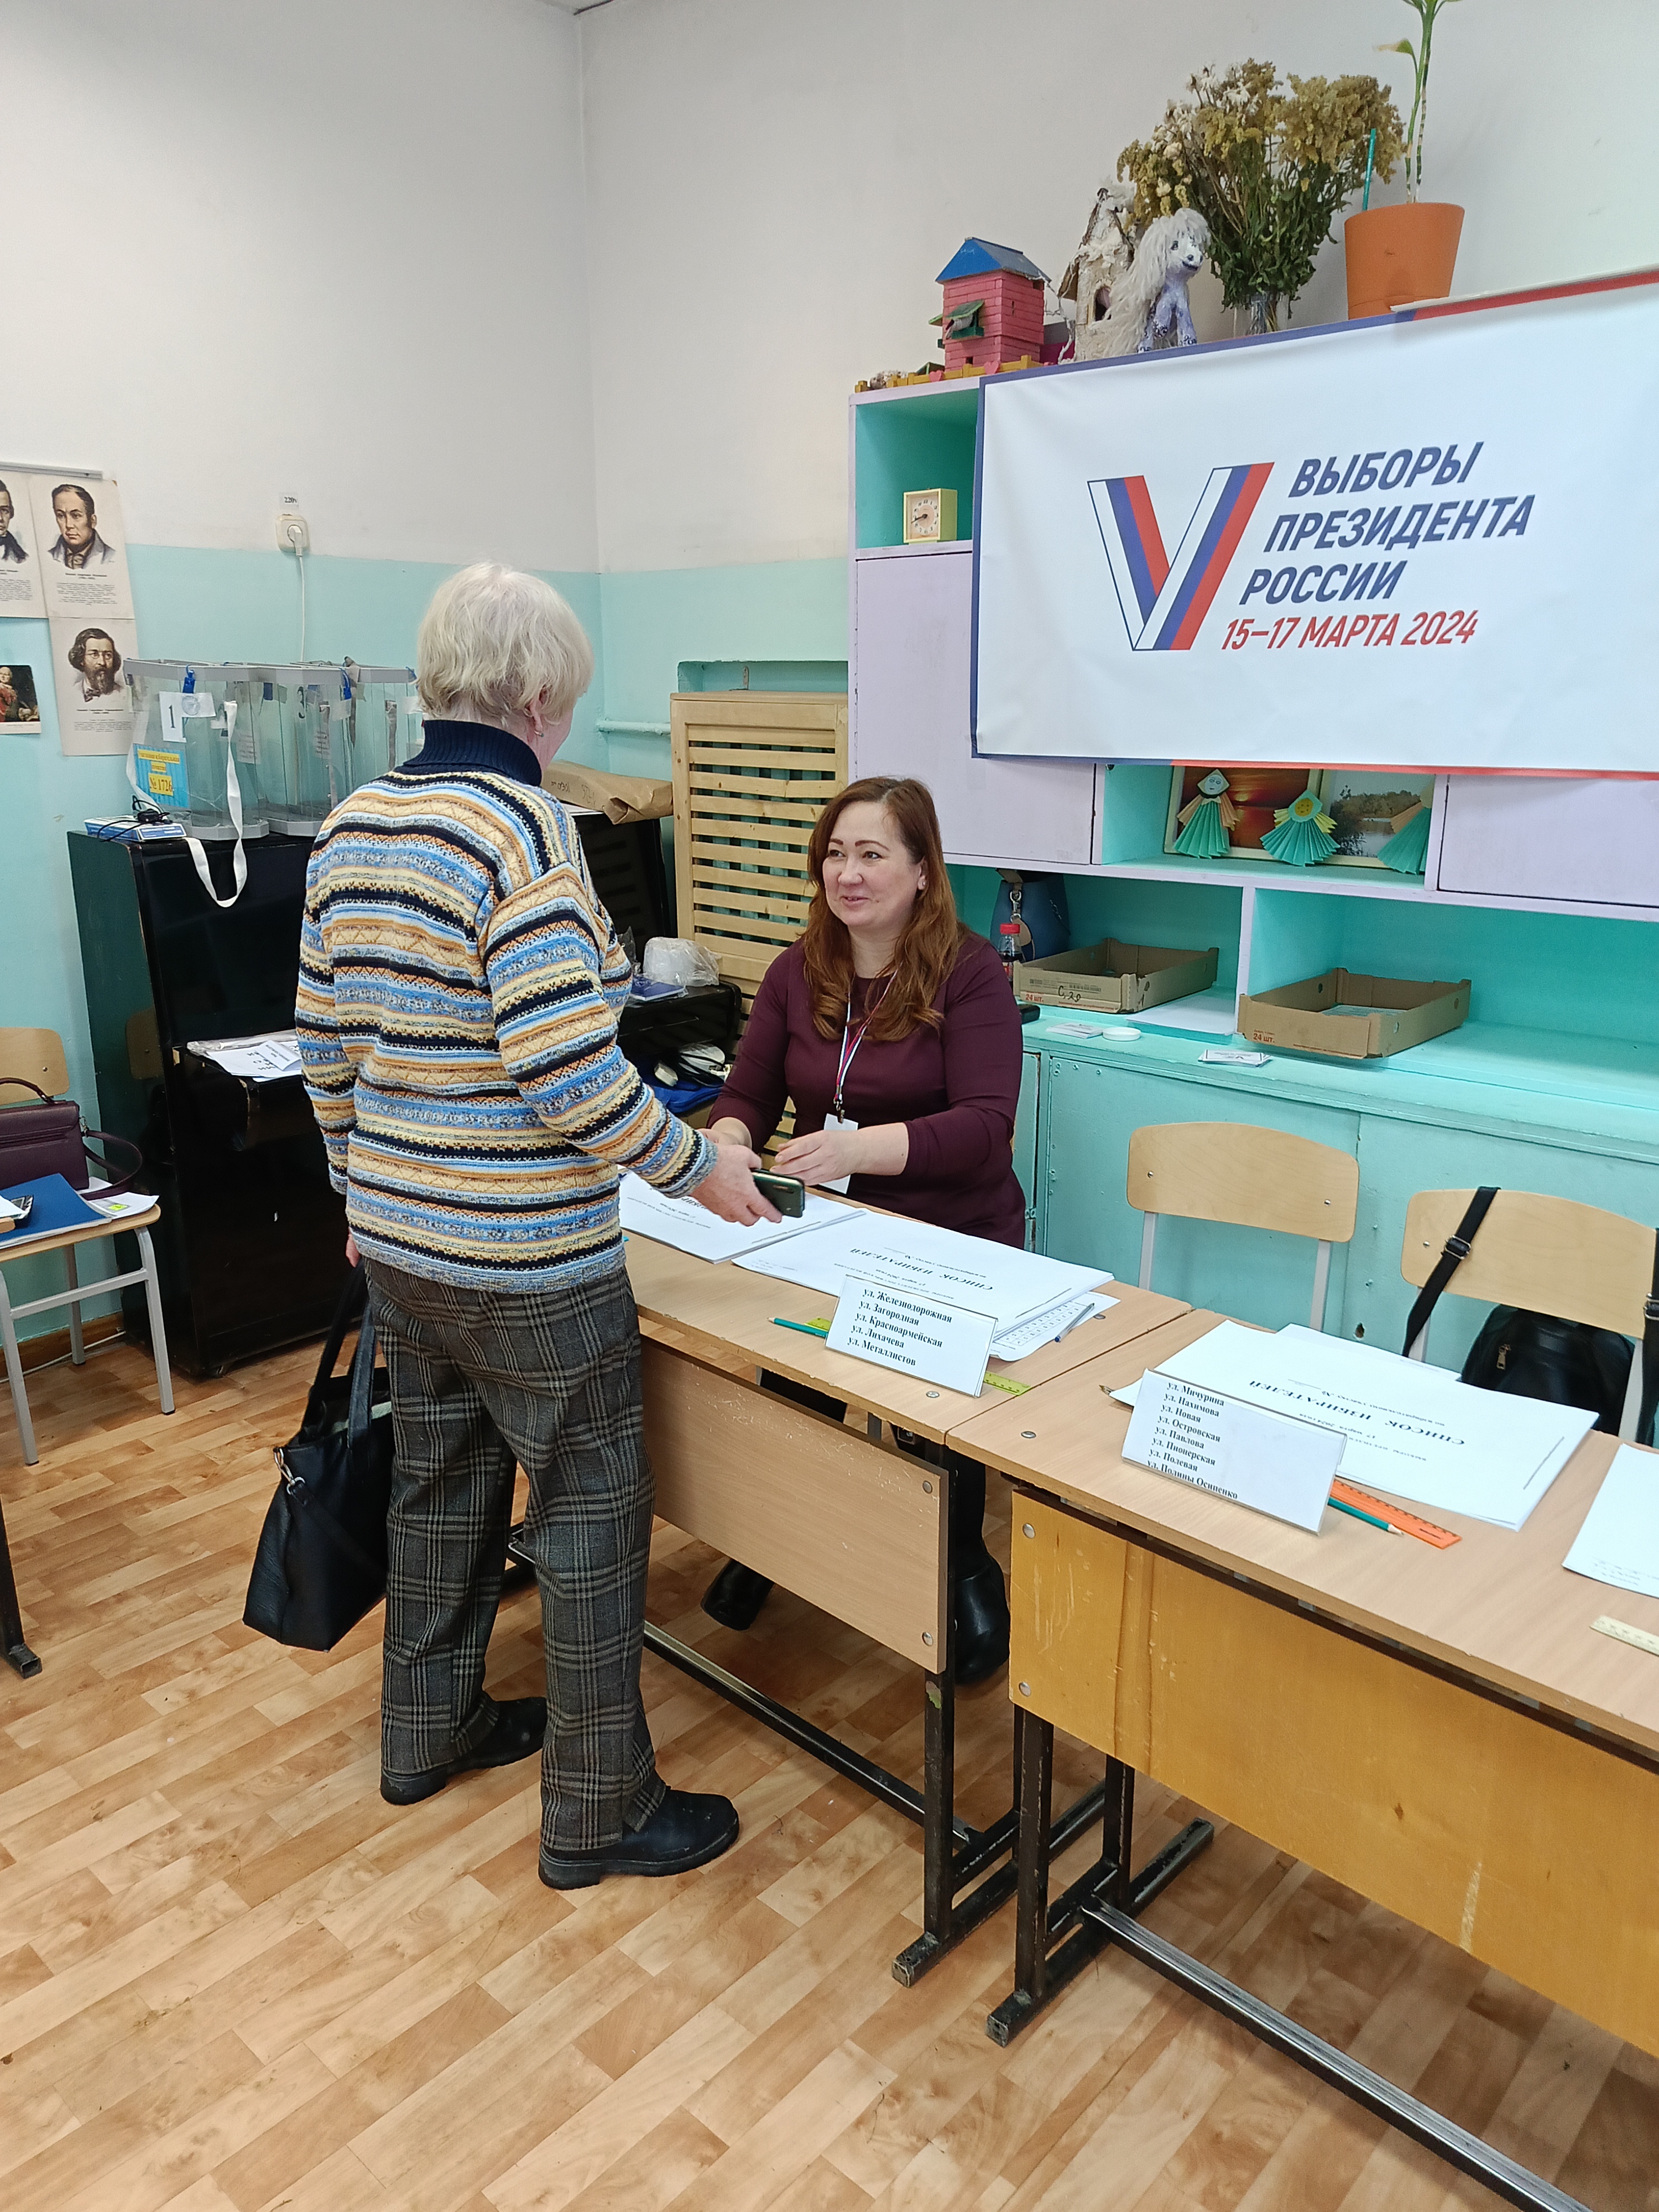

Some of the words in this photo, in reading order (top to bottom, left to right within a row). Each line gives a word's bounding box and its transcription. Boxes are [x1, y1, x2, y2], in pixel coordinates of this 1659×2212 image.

[1288, 441, 1484, 498] ВЫБОРЫ
[1264, 494, 1536, 552] ПРЕЗИДЕНТА
[1239, 560, 1408, 605] РОССИИ
[1297, 613, 1400, 648] МАРТА
[1400, 610, 1479, 646] 2024
[169, 705, 175, 728] 1
[1253, 1032, 1262, 1041] 24
[850, 1249, 933, 1274] ИЗБИРАТЕЛЕЙ
[940, 1274, 993, 1290] СПИСОК
[858, 1301, 871, 1310] ул.
[873, 1303, 920, 1326] Загородная
[862, 1288, 874, 1298] ул.
[877, 1291, 952, 1323] Железнодорожная
[851, 1325, 863, 1334] ул.
[865, 1328, 904, 1348] Лихачева
[855, 1313, 867, 1322] ул.
[869, 1315, 943, 1348] Красноармейская
[847, 1337, 859, 1346] ул.
[862, 1339, 916, 1366] Металлистов
[1164, 1393, 1176, 1402] ул.
[1178, 1396, 1219, 1417] Нахимова
[1166, 1382, 1179, 1391] ул.
[1181, 1385, 1224, 1406] Мичурина
[1249, 1381, 1371, 1420] ИЗБИРАТЕЛЕЙ
[1161, 1404, 1173, 1413] ул.
[1175, 1407, 1201, 1423] Новая
[1155, 1426, 1167, 1436] ул.
[1169, 1430, 1204, 1449] Павлова
[1157, 1415, 1170, 1424] ул.
[1172, 1418, 1220, 1443] Островская
[1385, 1420, 1464, 1444] СПИСОК
[1149, 1448, 1161, 1458] ул.
[1163, 1452, 1198, 1472] Полевая
[1151, 1437, 1164, 1447] ул.
[1166, 1441, 1215, 1466] Пионерская
[1147, 1460, 1159, 1469] ул.
[1161, 1464, 1194, 1483] Полины
[1196, 1477, 1238, 1499] Осипенко
